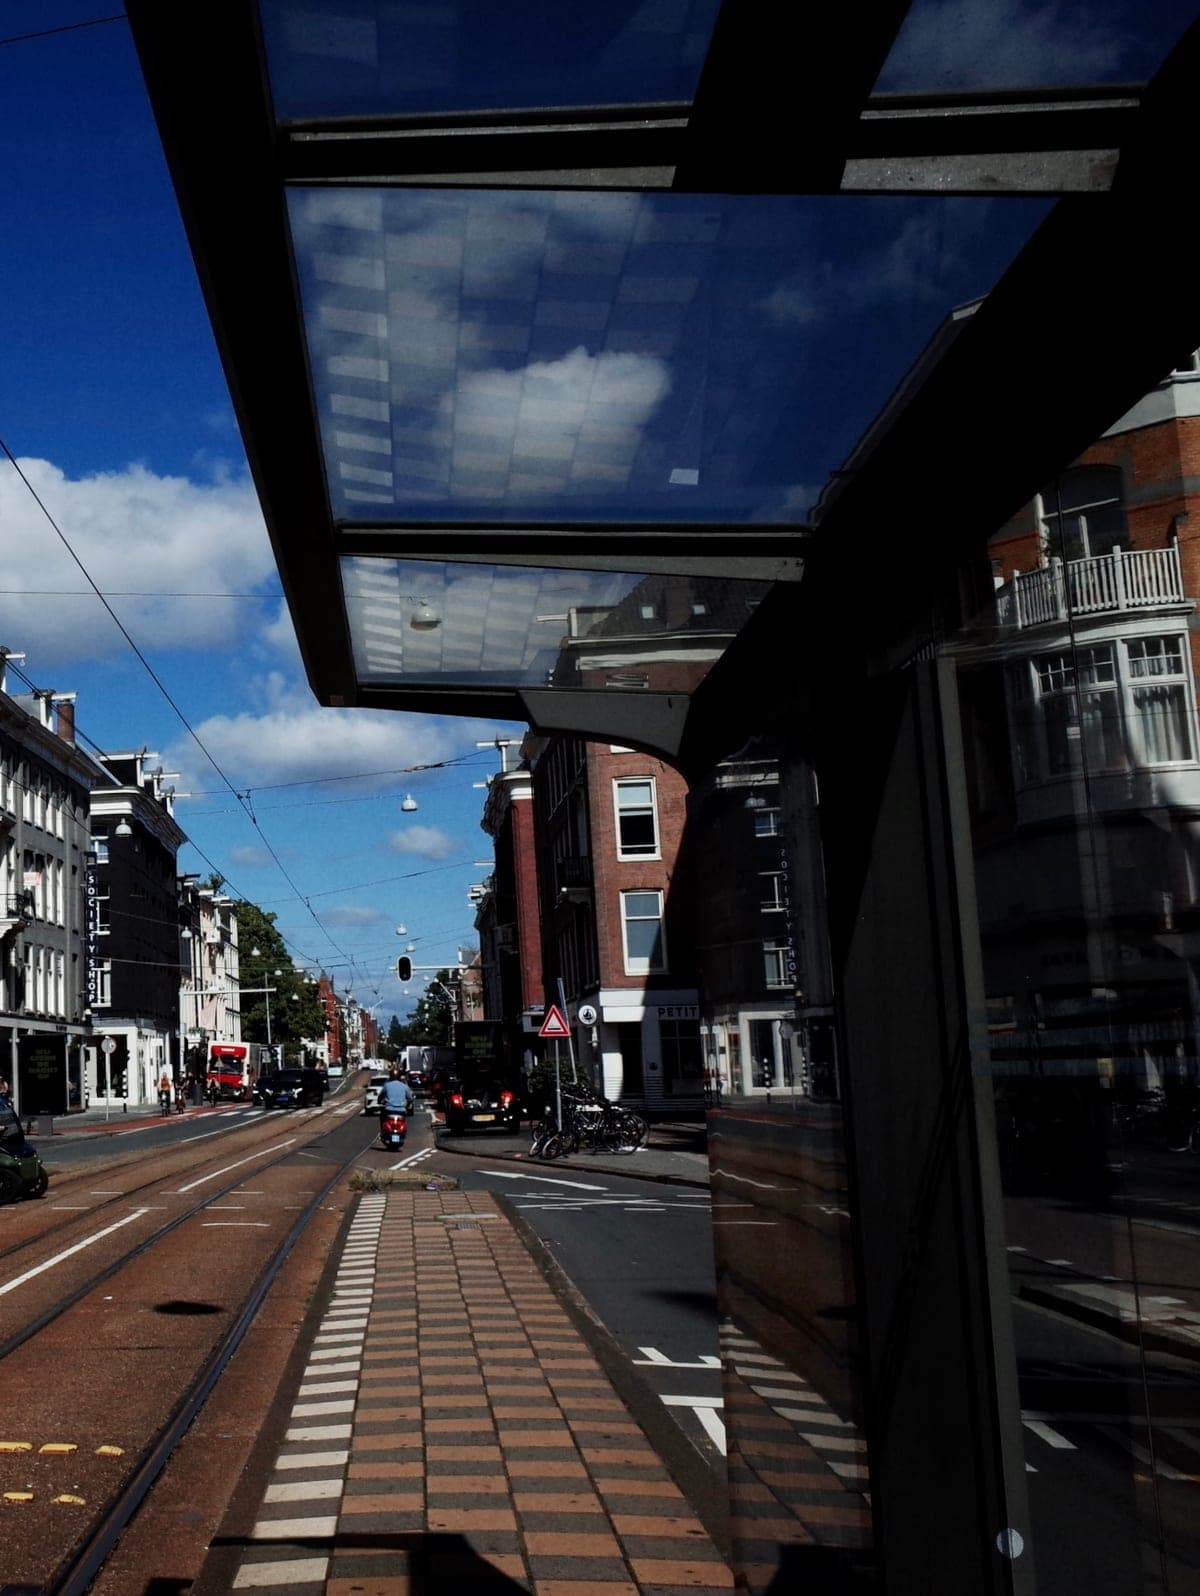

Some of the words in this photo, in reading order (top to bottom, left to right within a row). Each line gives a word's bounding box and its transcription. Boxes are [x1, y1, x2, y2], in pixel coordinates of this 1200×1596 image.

[87, 874, 96, 954] SOCIETY
[87, 958, 96, 1003] SHOP
[657, 1007, 697, 1017] PETIT
